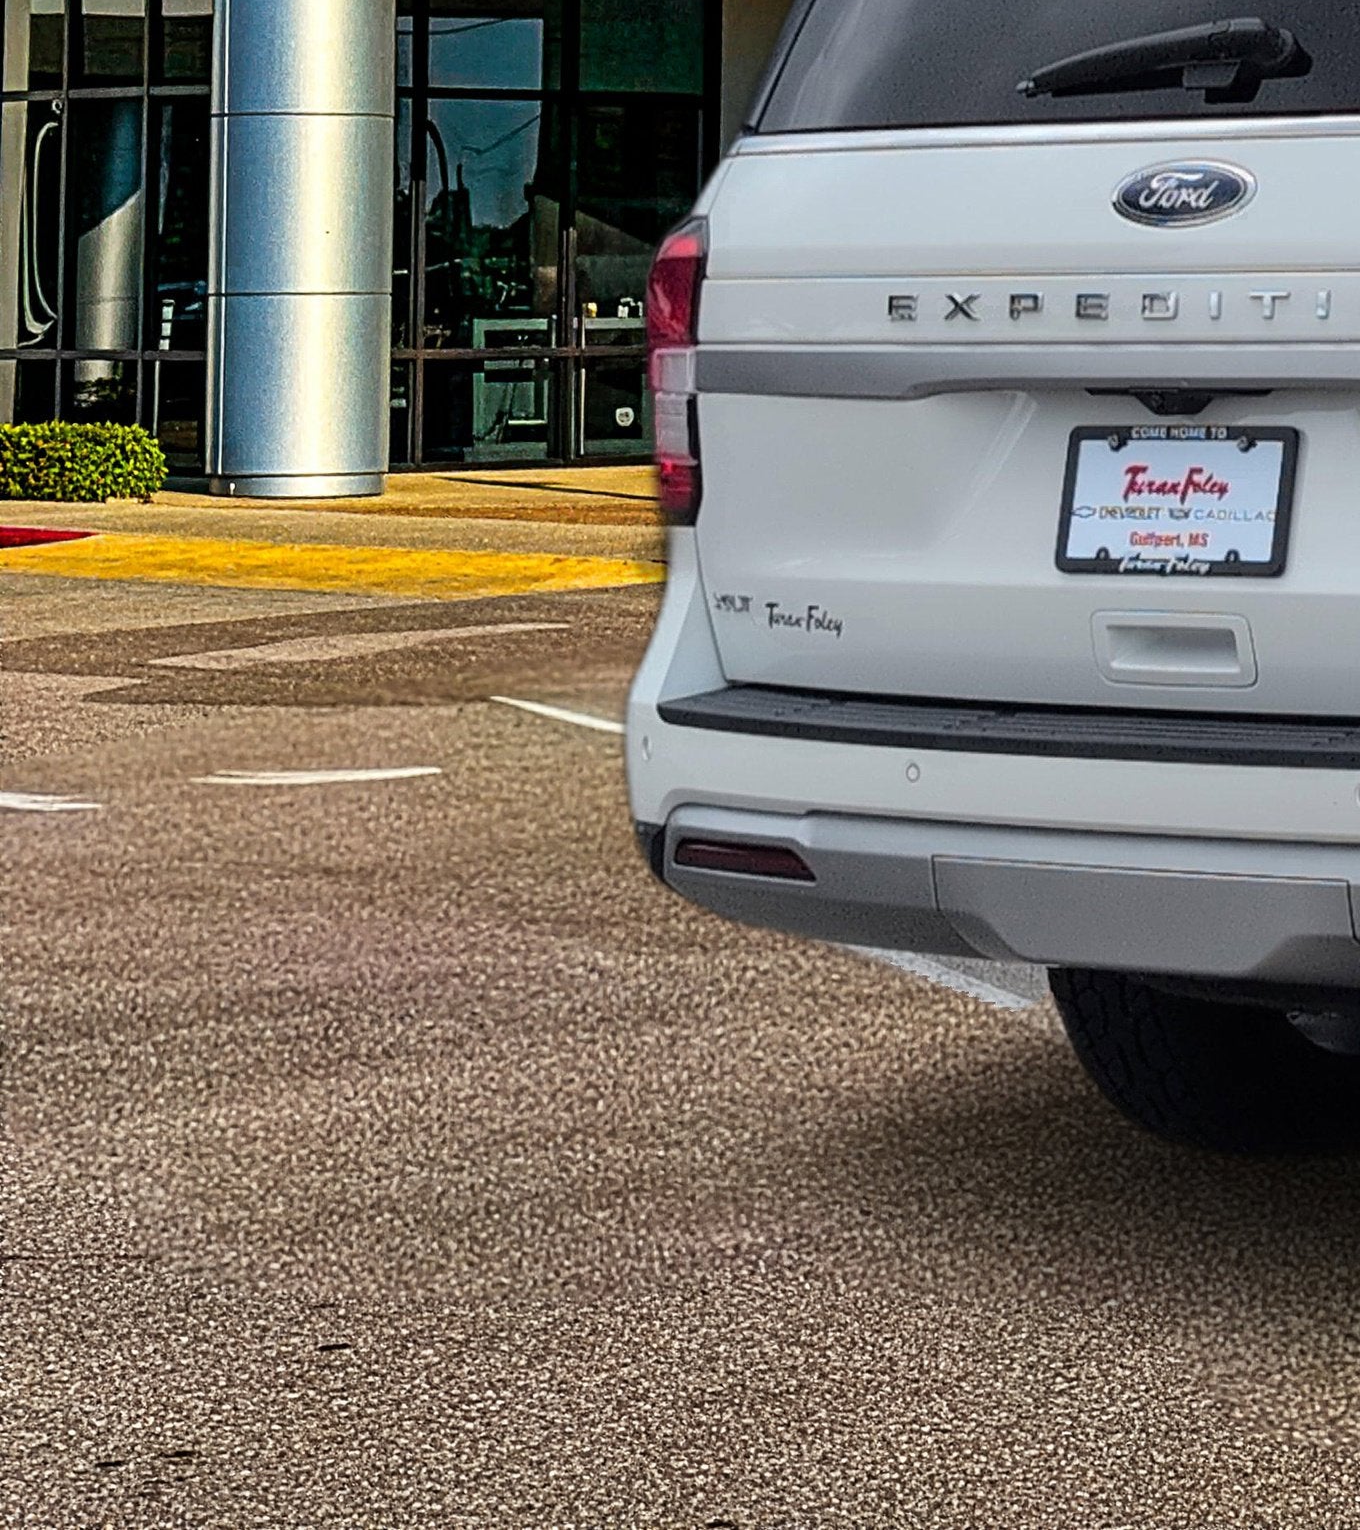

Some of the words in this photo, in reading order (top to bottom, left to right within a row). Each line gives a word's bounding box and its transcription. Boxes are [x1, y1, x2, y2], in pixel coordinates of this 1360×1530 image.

[1138, 173, 1215, 211] Ford
[1131, 426, 1167, 439] COME
[1169, 426, 1206, 439] HOME
[1211, 427, 1228, 439] TO
[1187, 532, 1209, 548] MS
